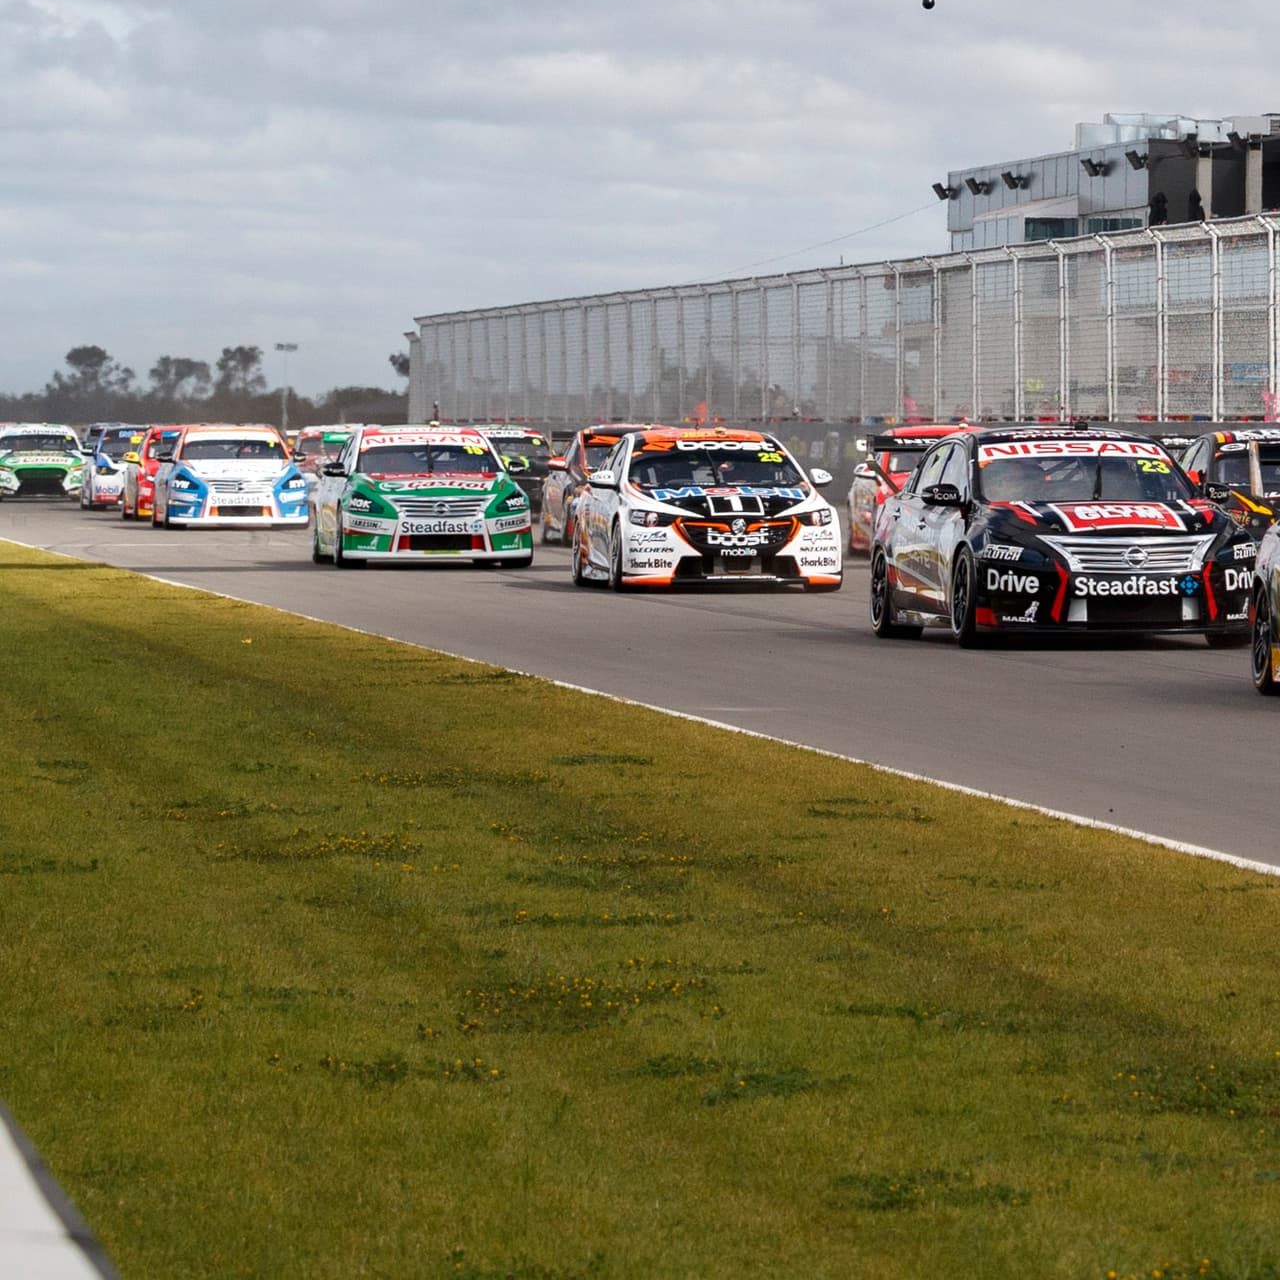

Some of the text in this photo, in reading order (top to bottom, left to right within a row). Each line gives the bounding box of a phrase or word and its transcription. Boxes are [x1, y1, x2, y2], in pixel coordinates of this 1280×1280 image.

[366, 436, 481, 445] NISSAN
[676, 440, 776, 451] boost
[983, 442, 1161, 457] NISSAN
[757, 452, 783, 462] 25
[1136, 459, 1171, 475] 23
[407, 480, 489, 489] Castrol
[211, 495, 261, 505] Steadfast
[650, 487, 806, 512] Mobil 1
[401, 521, 468, 535] Steadfast
[720, 548, 757, 557] mobile
[987, 569, 1040, 594] Drive
[1074, 576, 1178, 596] Steadfast
[1225, 567, 1255, 591] Driv
